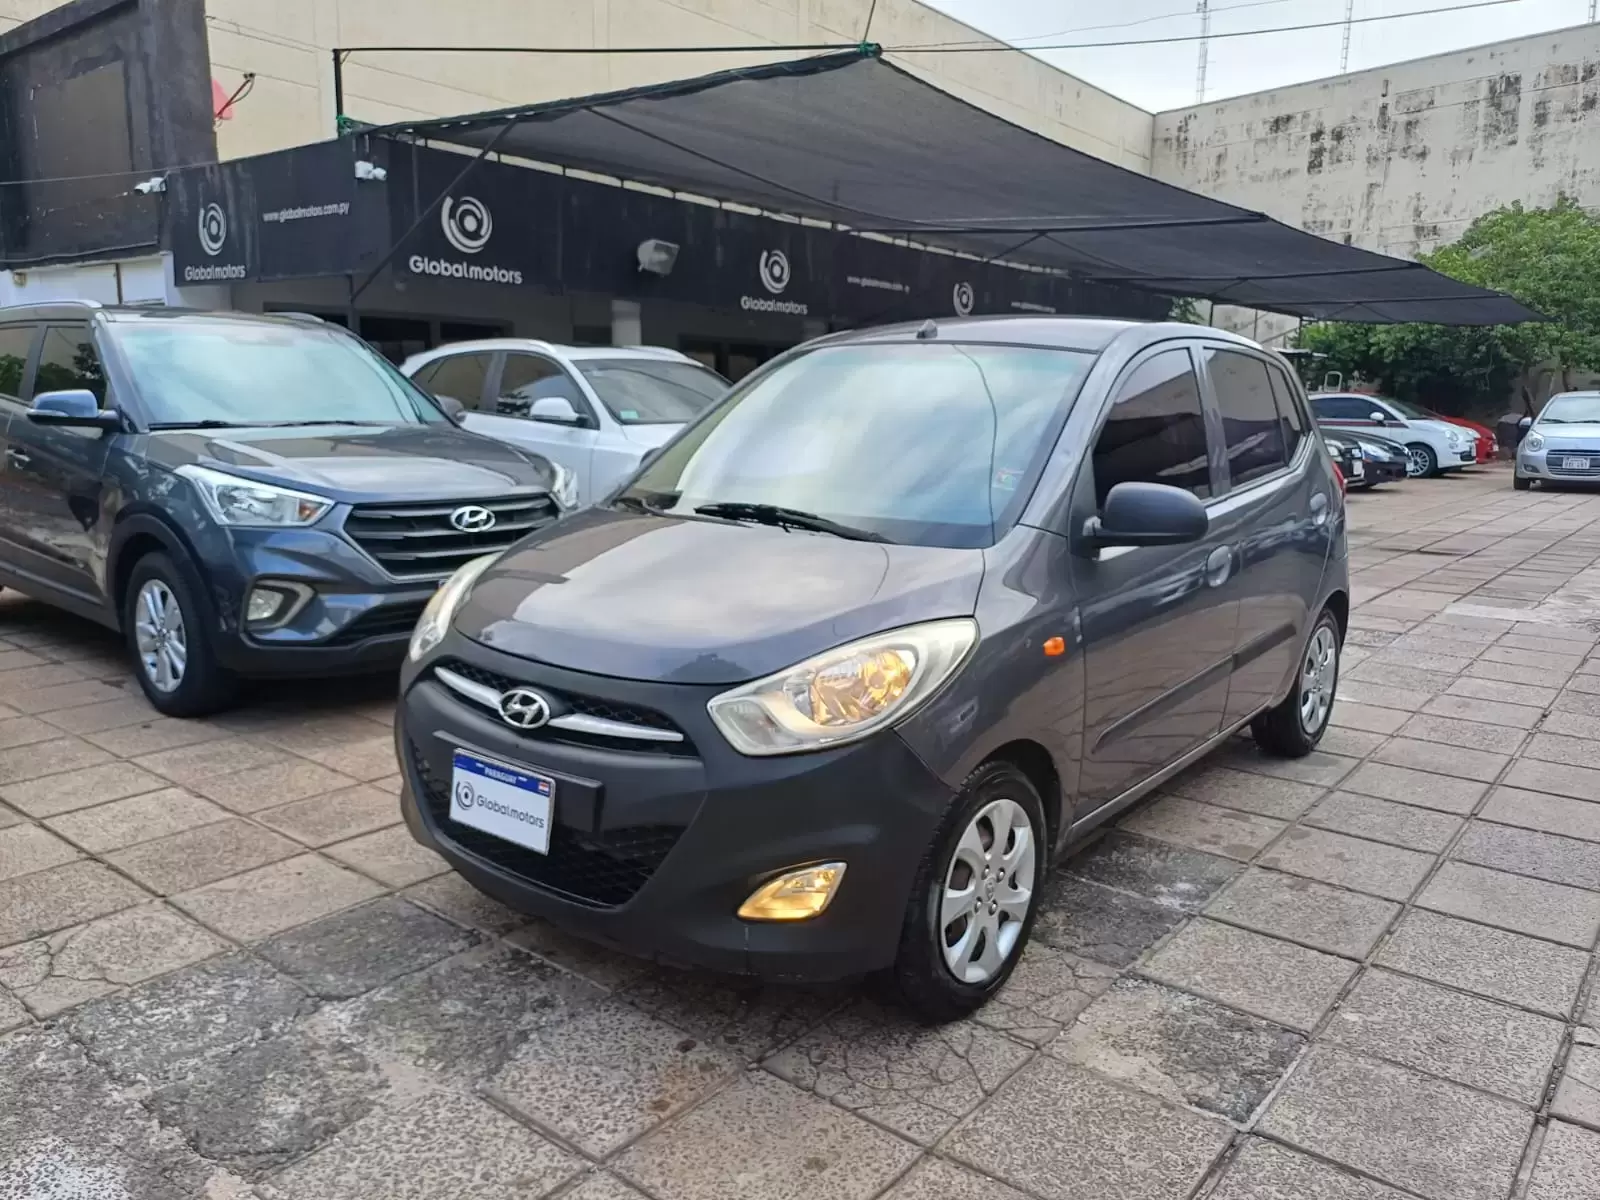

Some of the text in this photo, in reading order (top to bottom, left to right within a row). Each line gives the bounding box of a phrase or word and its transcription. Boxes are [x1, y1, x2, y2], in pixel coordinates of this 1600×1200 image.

[184, 264, 247, 281] Globalmotors
[409, 255, 523, 285] Globalmotors
[484, 767, 518, 784] PARAGUAY
